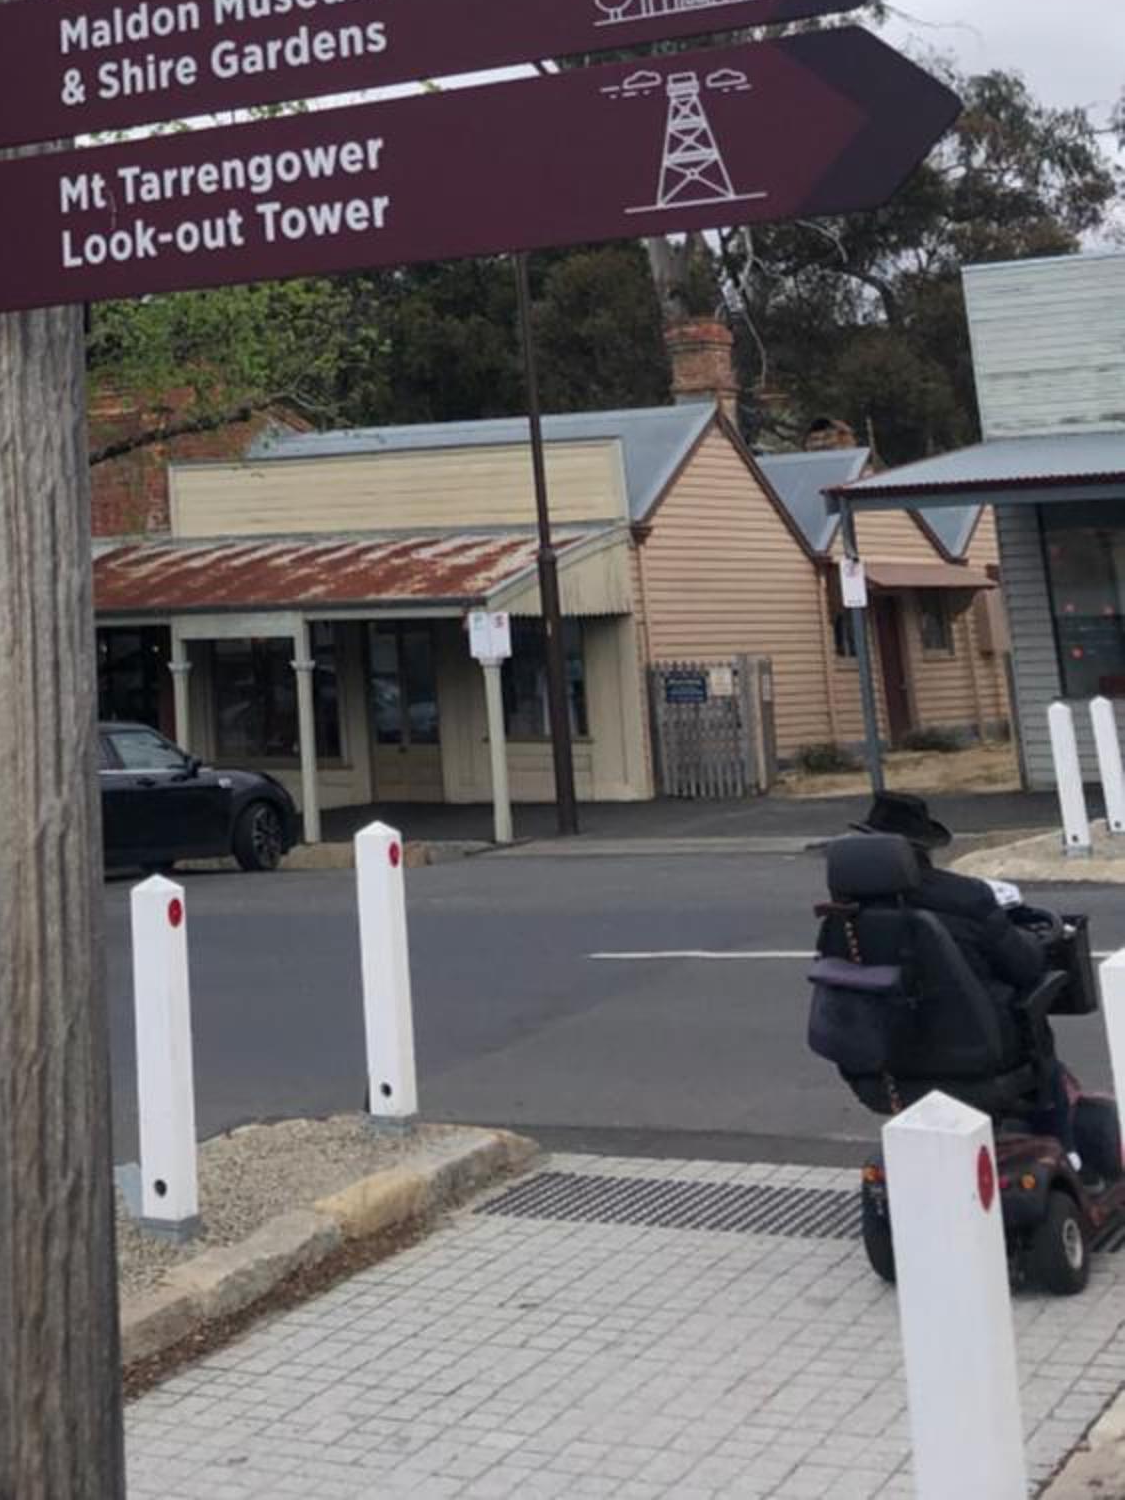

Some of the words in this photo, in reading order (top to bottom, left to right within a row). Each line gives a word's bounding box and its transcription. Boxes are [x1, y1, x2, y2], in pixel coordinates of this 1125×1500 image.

[60, 1, 200, 54] Maldon
[61, 68, 86, 106] &
[98, 53, 198, 99] Shire
[210, 21, 387, 79] Gardens
[60, 173, 107, 213] Mt
[117, 137, 384, 204] Tarrengower
[62, 208, 245, 268] Look-out
[255, 195, 390, 242] Tower
